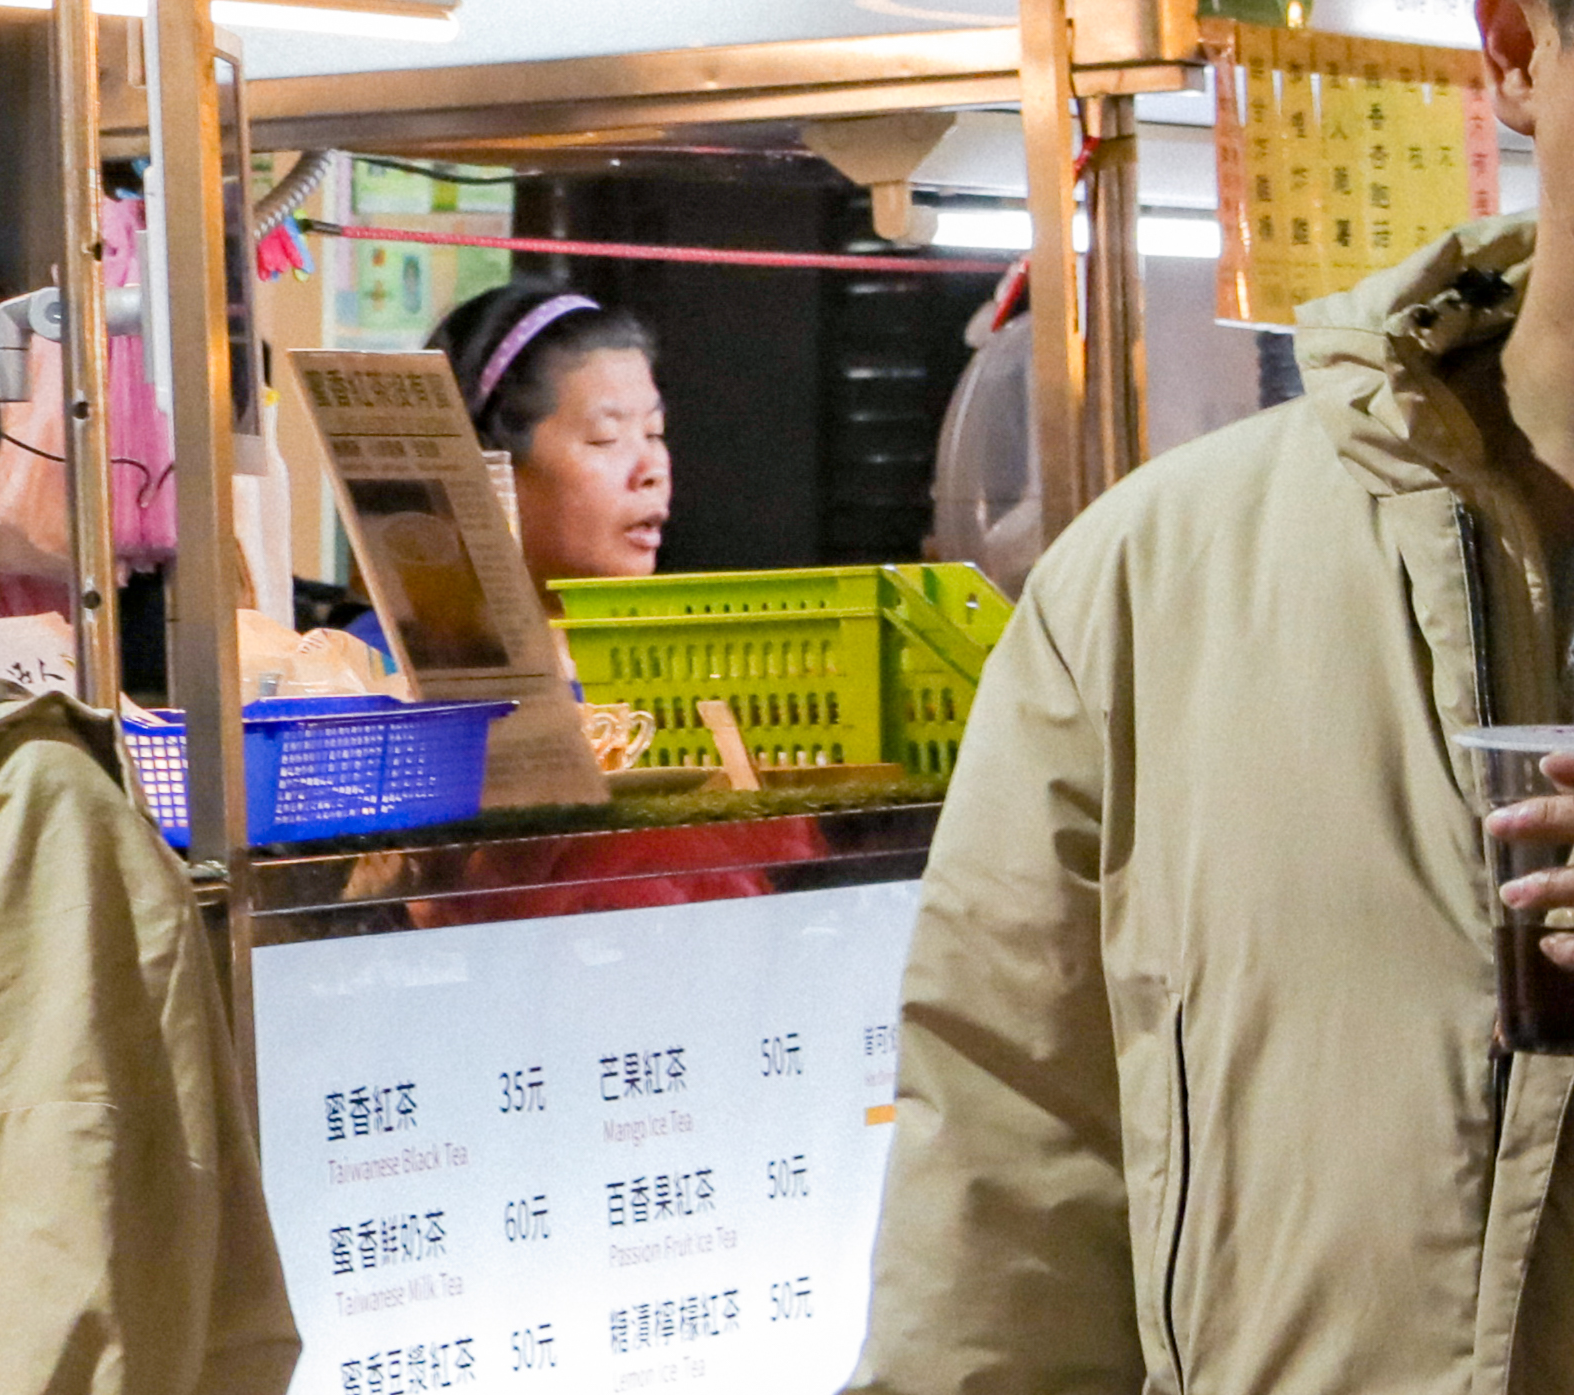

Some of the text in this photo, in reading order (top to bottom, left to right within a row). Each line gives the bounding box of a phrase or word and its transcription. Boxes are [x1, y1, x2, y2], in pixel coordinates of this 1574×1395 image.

[599, 1047, 687, 1101] 芒果紅茶
[761, 1033, 804, 1078] 50元
[326, 1066, 547, 1141] 蜜香紅茶 35元
[604, 1116, 648, 1146] Mango
[669, 1110, 695, 1135] Tea
[328, 1141, 470, 1185] Taiwanese Black Tea
[606, 1155, 810, 1226] 百香果紅茶 50元
[330, 1195, 552, 1275] 蜜香鮮奶茶 60元
[609, 1240, 662, 1268] Passion
[716, 1226, 739, 1249] Tea
[440, 1272, 464, 1297] Tea
[771, 1276, 814, 1323] 50元
[510, 1323, 558, 1372] 50元
[682, 1354, 706, 1379] Tea
